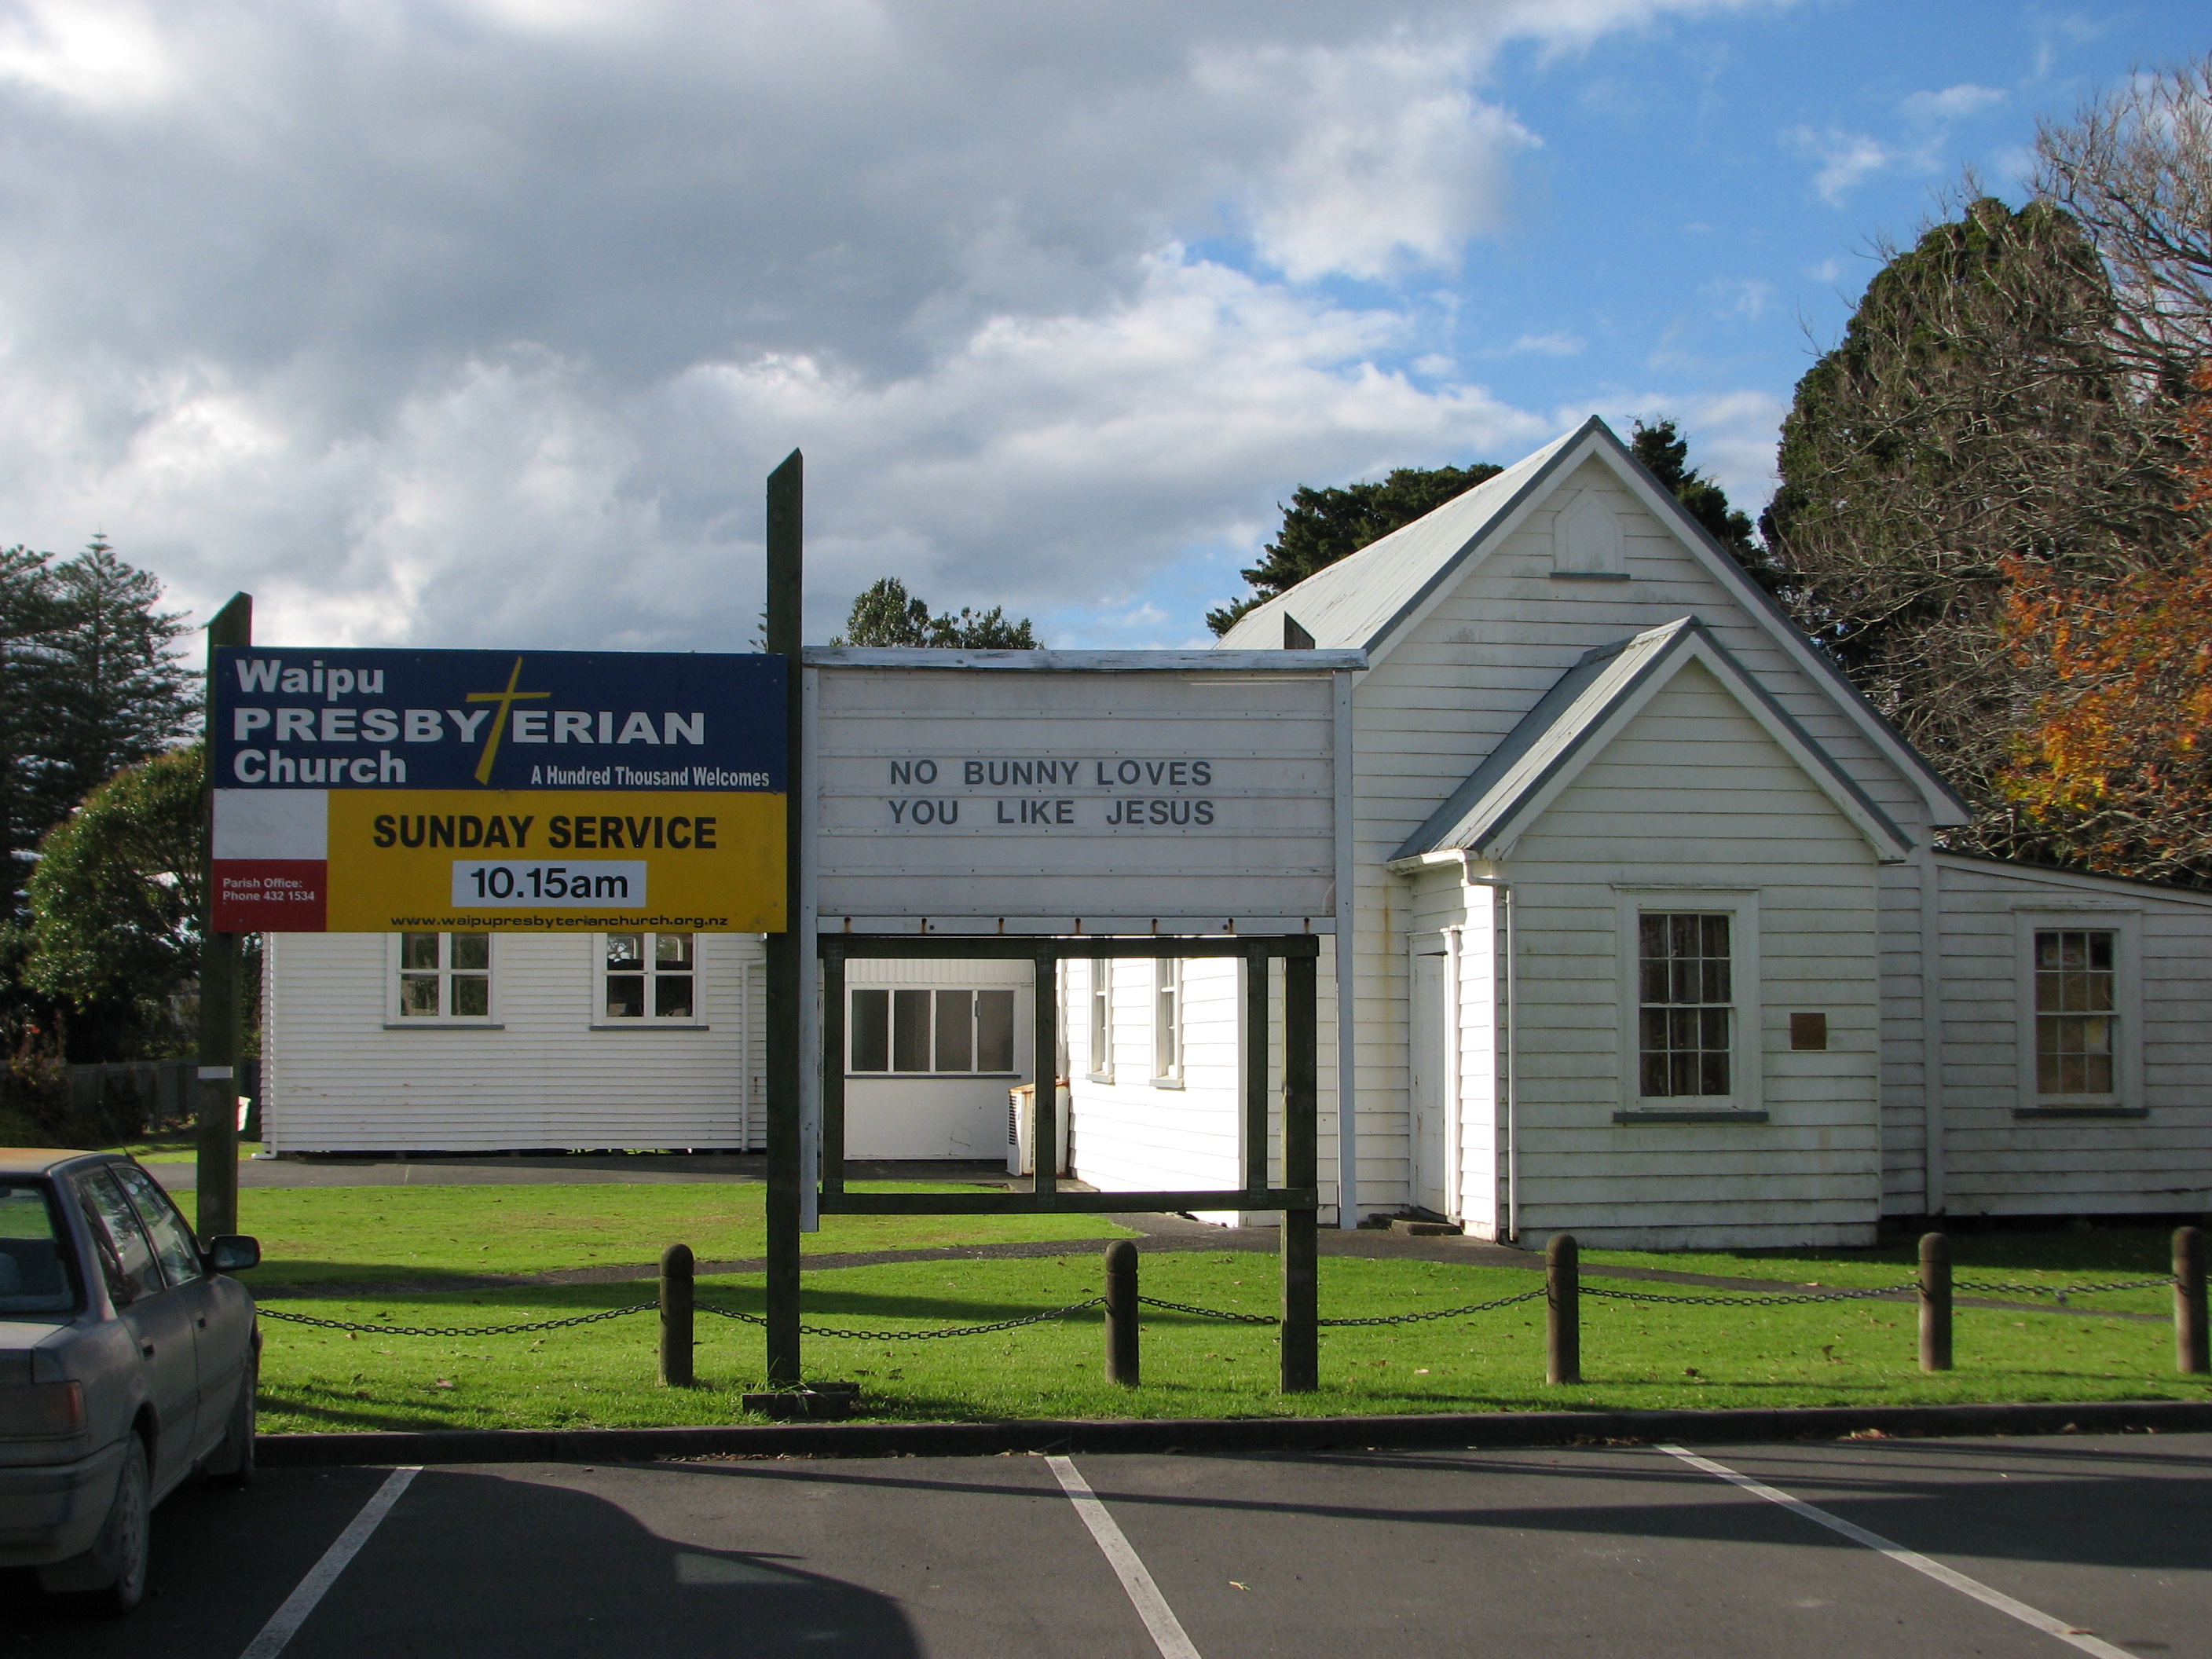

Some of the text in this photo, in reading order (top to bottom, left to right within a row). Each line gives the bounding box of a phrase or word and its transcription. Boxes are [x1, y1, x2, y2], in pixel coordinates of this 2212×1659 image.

[236, 659, 384, 701] Waipu
[234, 749, 406, 783] Church
[531, 765, 770, 786] A Hundred Thousand Welcomes
[891, 760, 1213, 786] NO BUNNY LOVES
[888, 800, 1214, 826] YOU LIKE JESUS
[373, 815, 717, 850] SUNDAY SERVICE
[222, 877, 302, 888] Parish Office:
[222, 890, 315, 901] Phone 432 1534
[471, 866, 628, 899] 10.15am
[390, 915, 728, 928] www.waipupresbyterianchurch.org.nz
